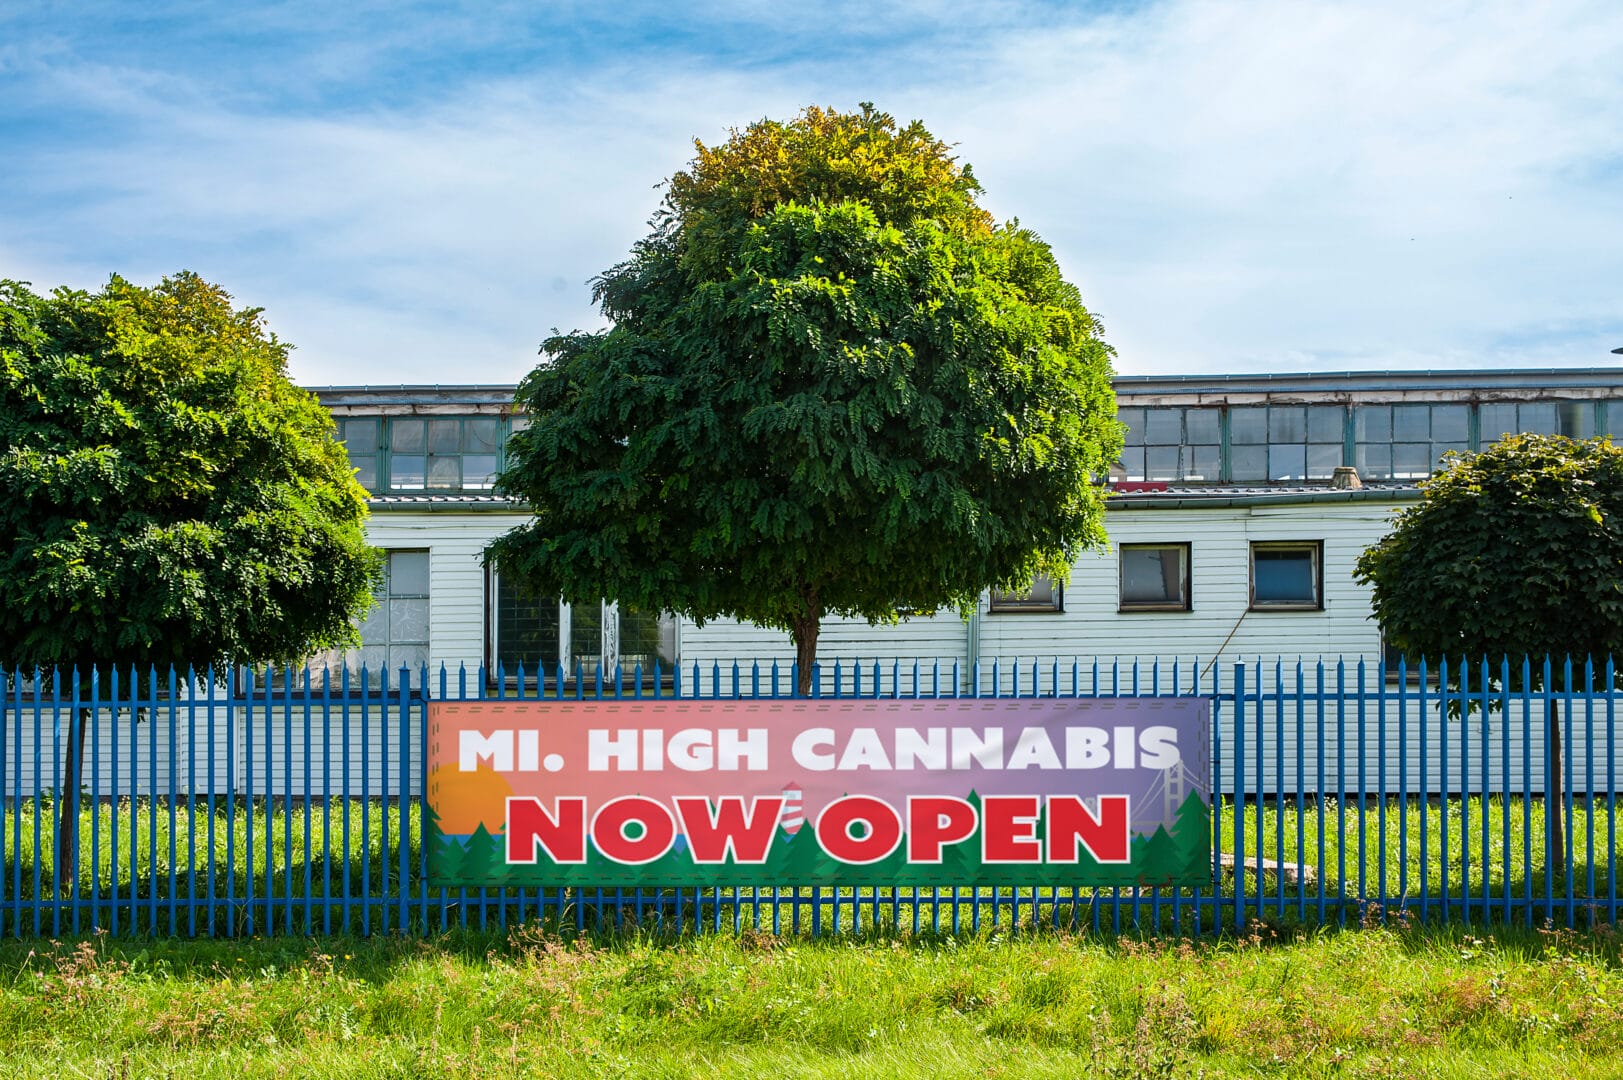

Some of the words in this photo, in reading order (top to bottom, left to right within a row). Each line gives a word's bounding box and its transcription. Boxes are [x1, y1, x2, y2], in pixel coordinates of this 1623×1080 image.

[458, 729, 565, 772] MI.
[588, 728, 769, 772] HIGH
[791, 725, 1181, 771] CANNABIS
[505, 794, 787, 865] NOW
[814, 794, 1131, 865] OPEN
